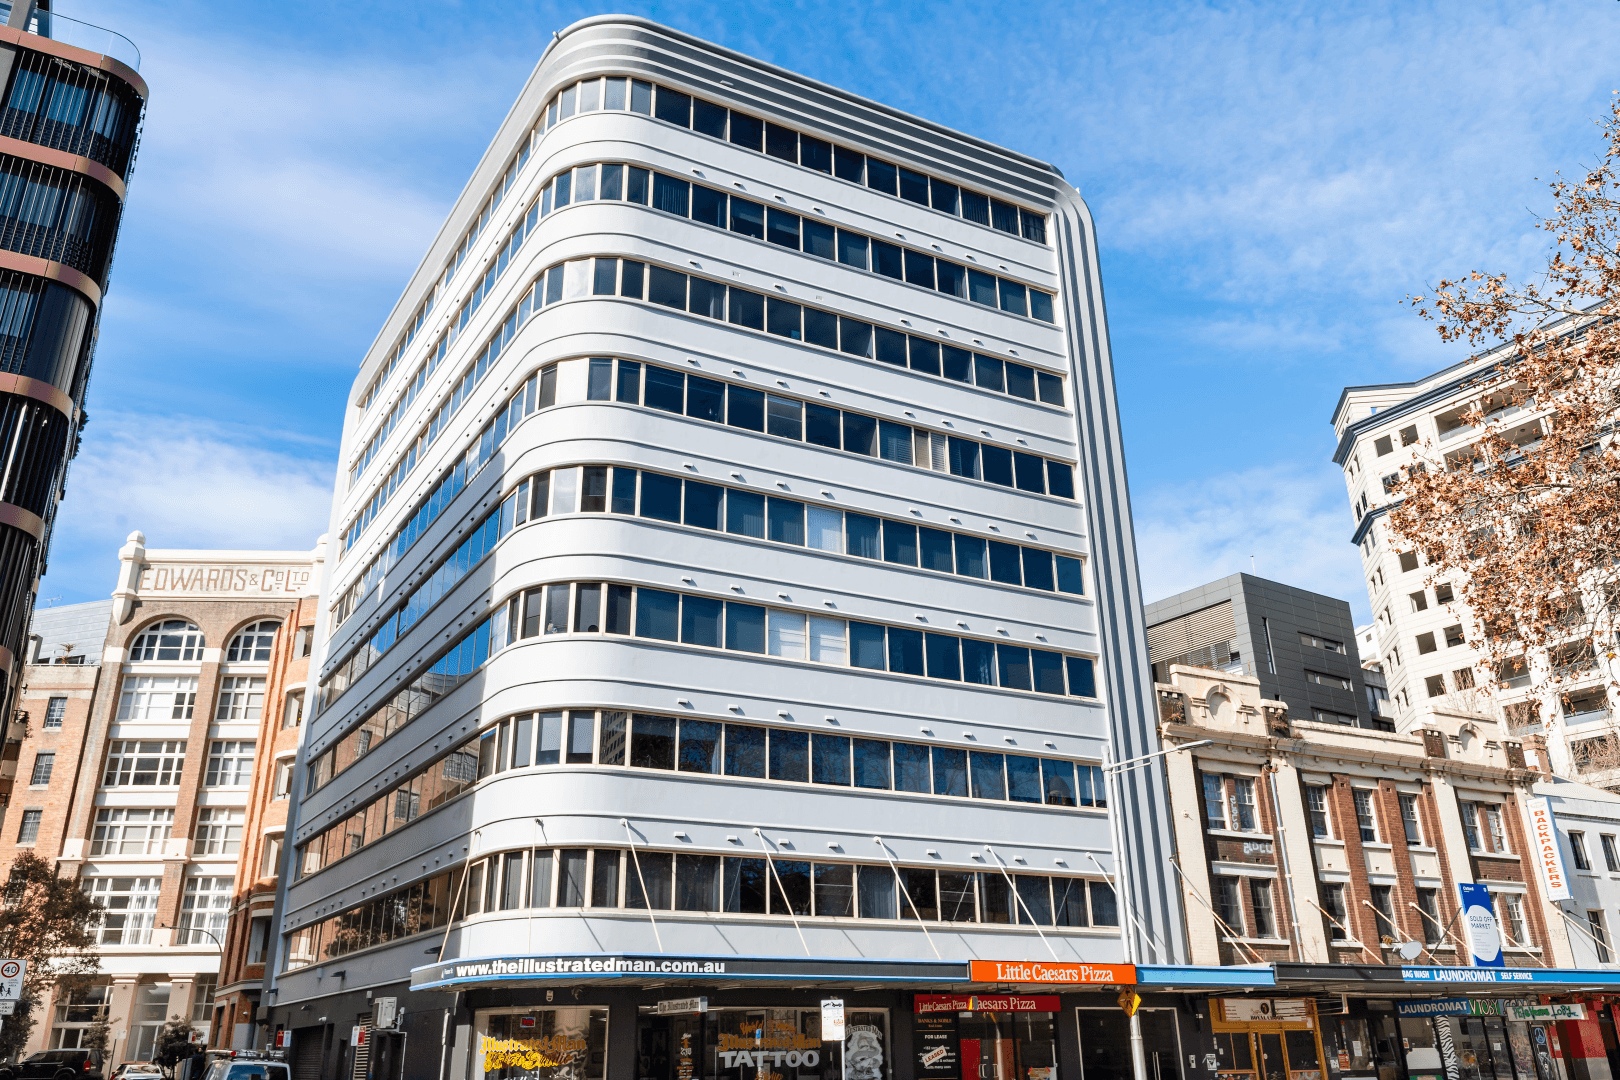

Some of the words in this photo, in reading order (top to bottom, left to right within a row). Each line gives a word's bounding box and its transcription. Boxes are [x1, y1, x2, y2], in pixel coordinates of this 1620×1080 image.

[139, 568, 248, 592] EDWARDS
[249, 573, 258, 586] &
[1533, 810, 1562, 888] BACKPACKERS
[1470, 922, 1491, 930] MARKET
[4, 966, 17, 974] 40
[456, 957, 725, 977] www.theillustratedman.com.au
[996, 963, 1032, 980] Little
[1032, 964, 1079, 981] Caesars
[1079, 965, 1114, 982] Pizza
[1401, 970, 1414, 978] BAG
[1413, 970, 1430, 979] WASH
[1433, 969, 1496, 981] LAUNDROMAT
[1500, 971, 1513, 980] SELF
[1513, 972, 1533, 980] SERVICE
[919, 1002, 933, 1012] Little
[932, 1001, 951, 1011] Caesars
[952, 1000, 967, 1010] Pizza
[977, 999, 1008, 1010] aesars
[1009, 997, 1036, 1010] Pizza
[1398, 1001, 1467, 1014] LAUNDROMAT
[717, 1033, 790, 1051] Illusrated
[719, 1050, 820, 1068] TATTOO
[925, 1049, 944, 1063] LEASED
